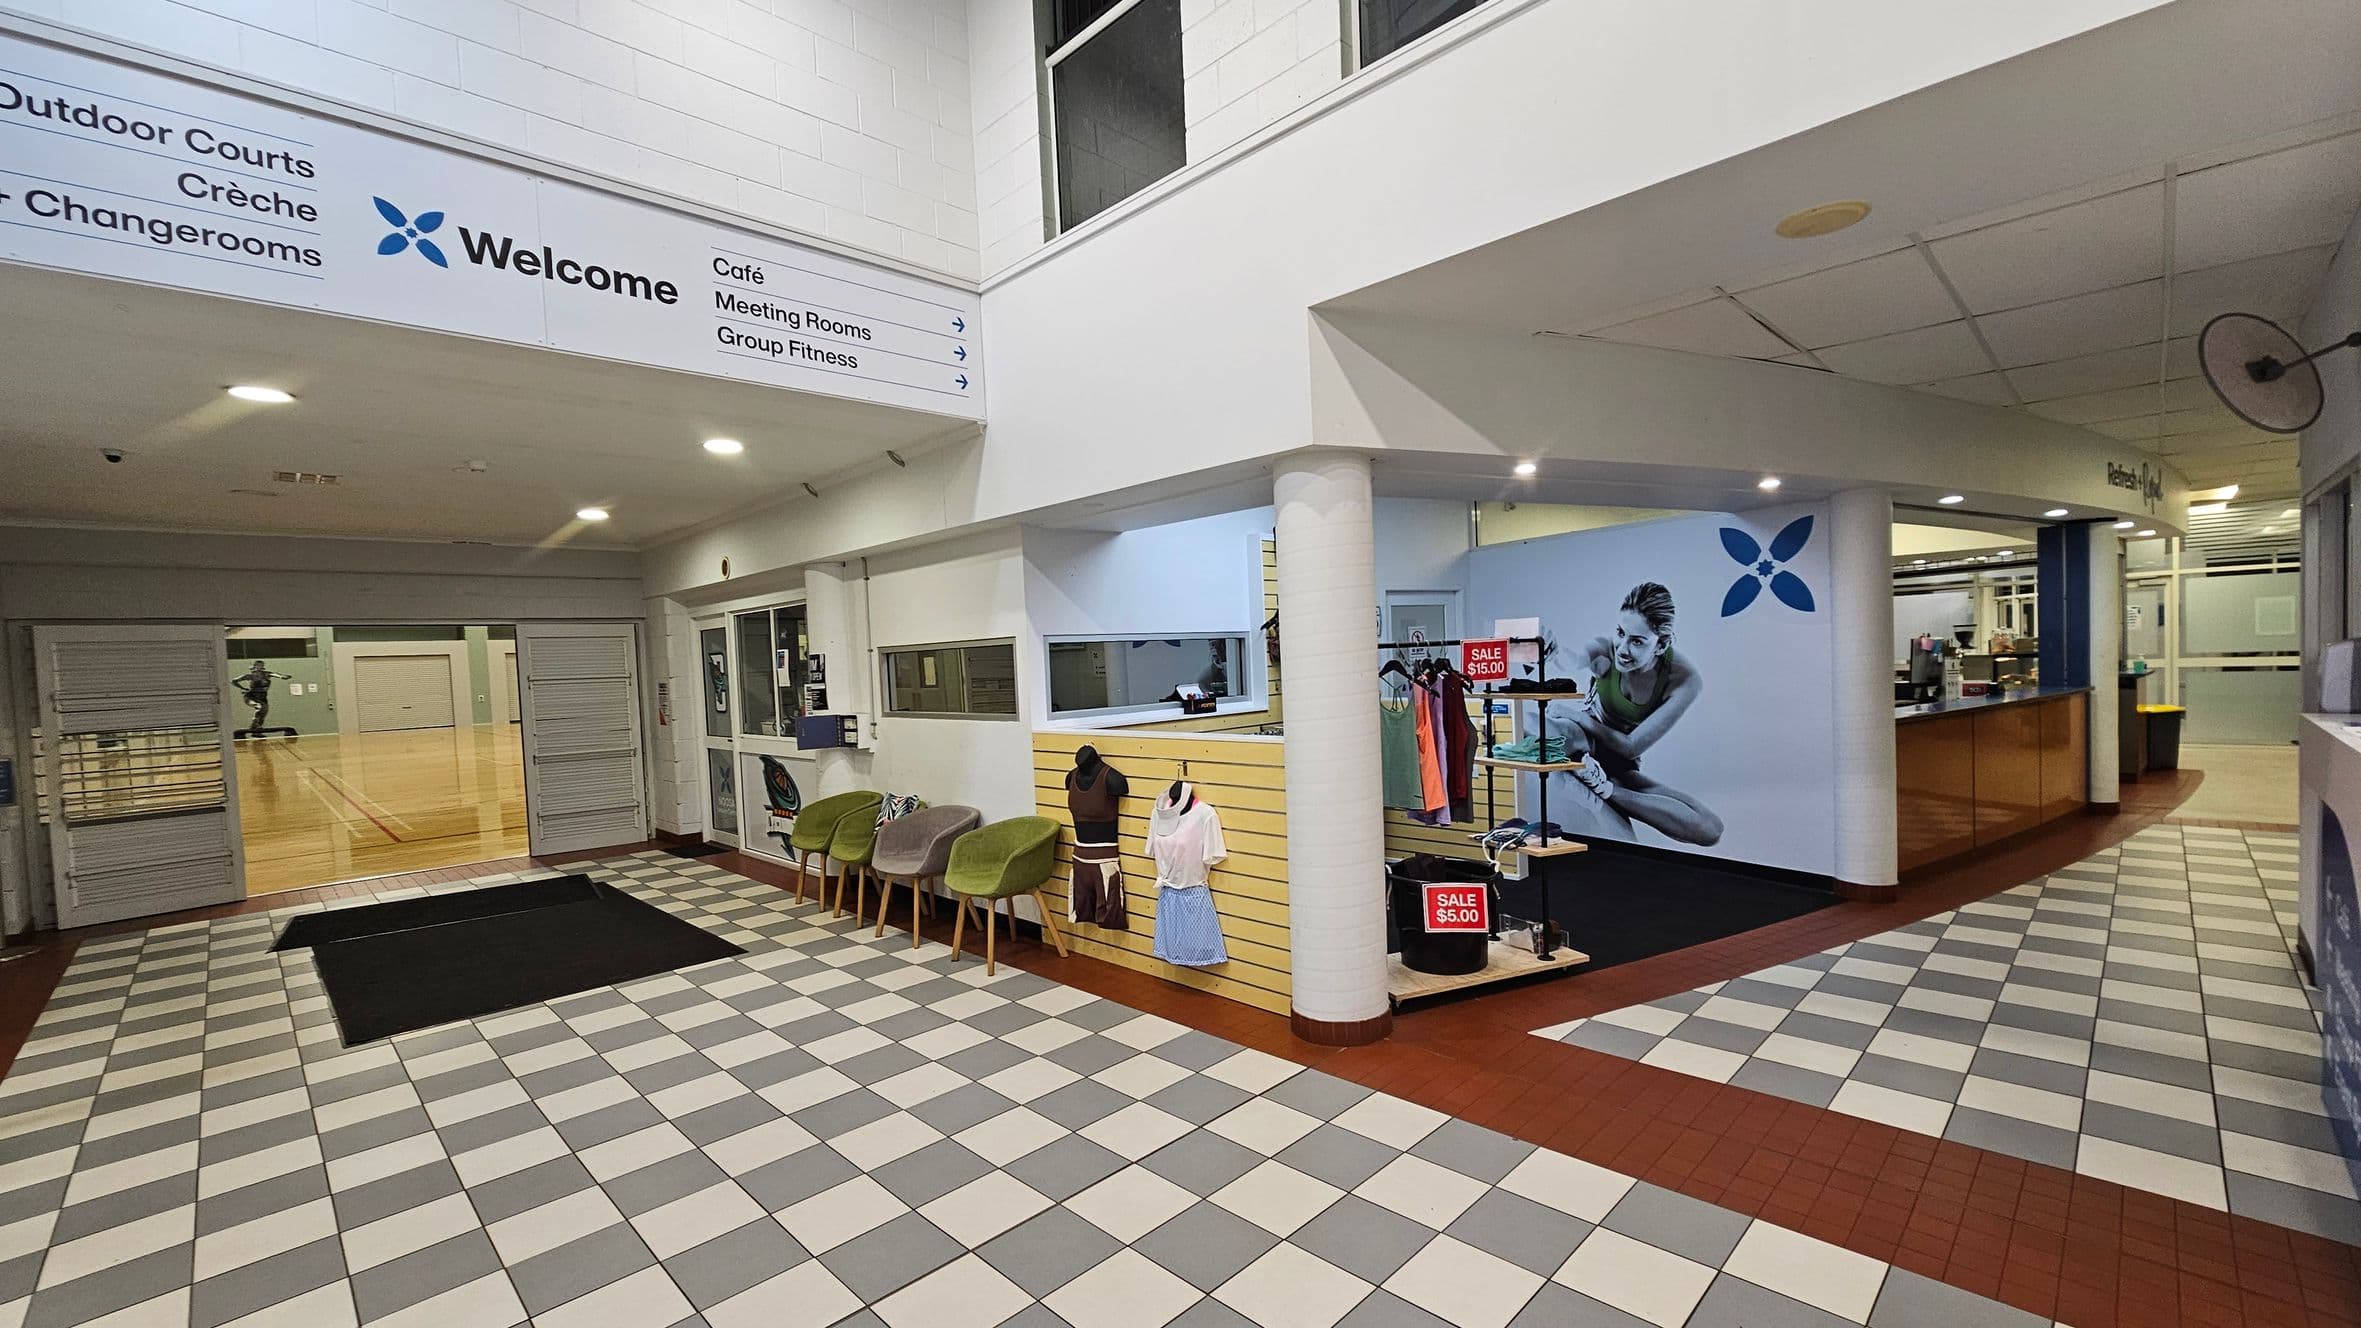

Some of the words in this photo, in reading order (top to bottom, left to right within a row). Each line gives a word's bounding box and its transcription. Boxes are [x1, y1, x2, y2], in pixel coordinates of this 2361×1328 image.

[0, 82, 173, 145] Outdoor
[185, 128, 315, 179] Courts
[177, 172, 318, 222] Crèche
[25, 189, 322, 267] Changerooms
[457, 225, 679, 305] Welcome
[712, 257, 765, 285] Café
[715, 290, 801, 330] Meeting
[805, 310, 872, 341] Rooms
[717, 326, 784, 358] Group
[789, 339, 858, 369] Fitness
[2107, 461, 2138, 491] Refresh
[1467, 661, 1505, 676] $15.00
[1471, 647, 1502, 661] SALE
[1436, 908, 1479, 924] $5.00
[1437, 893, 1477, 907] SALE
